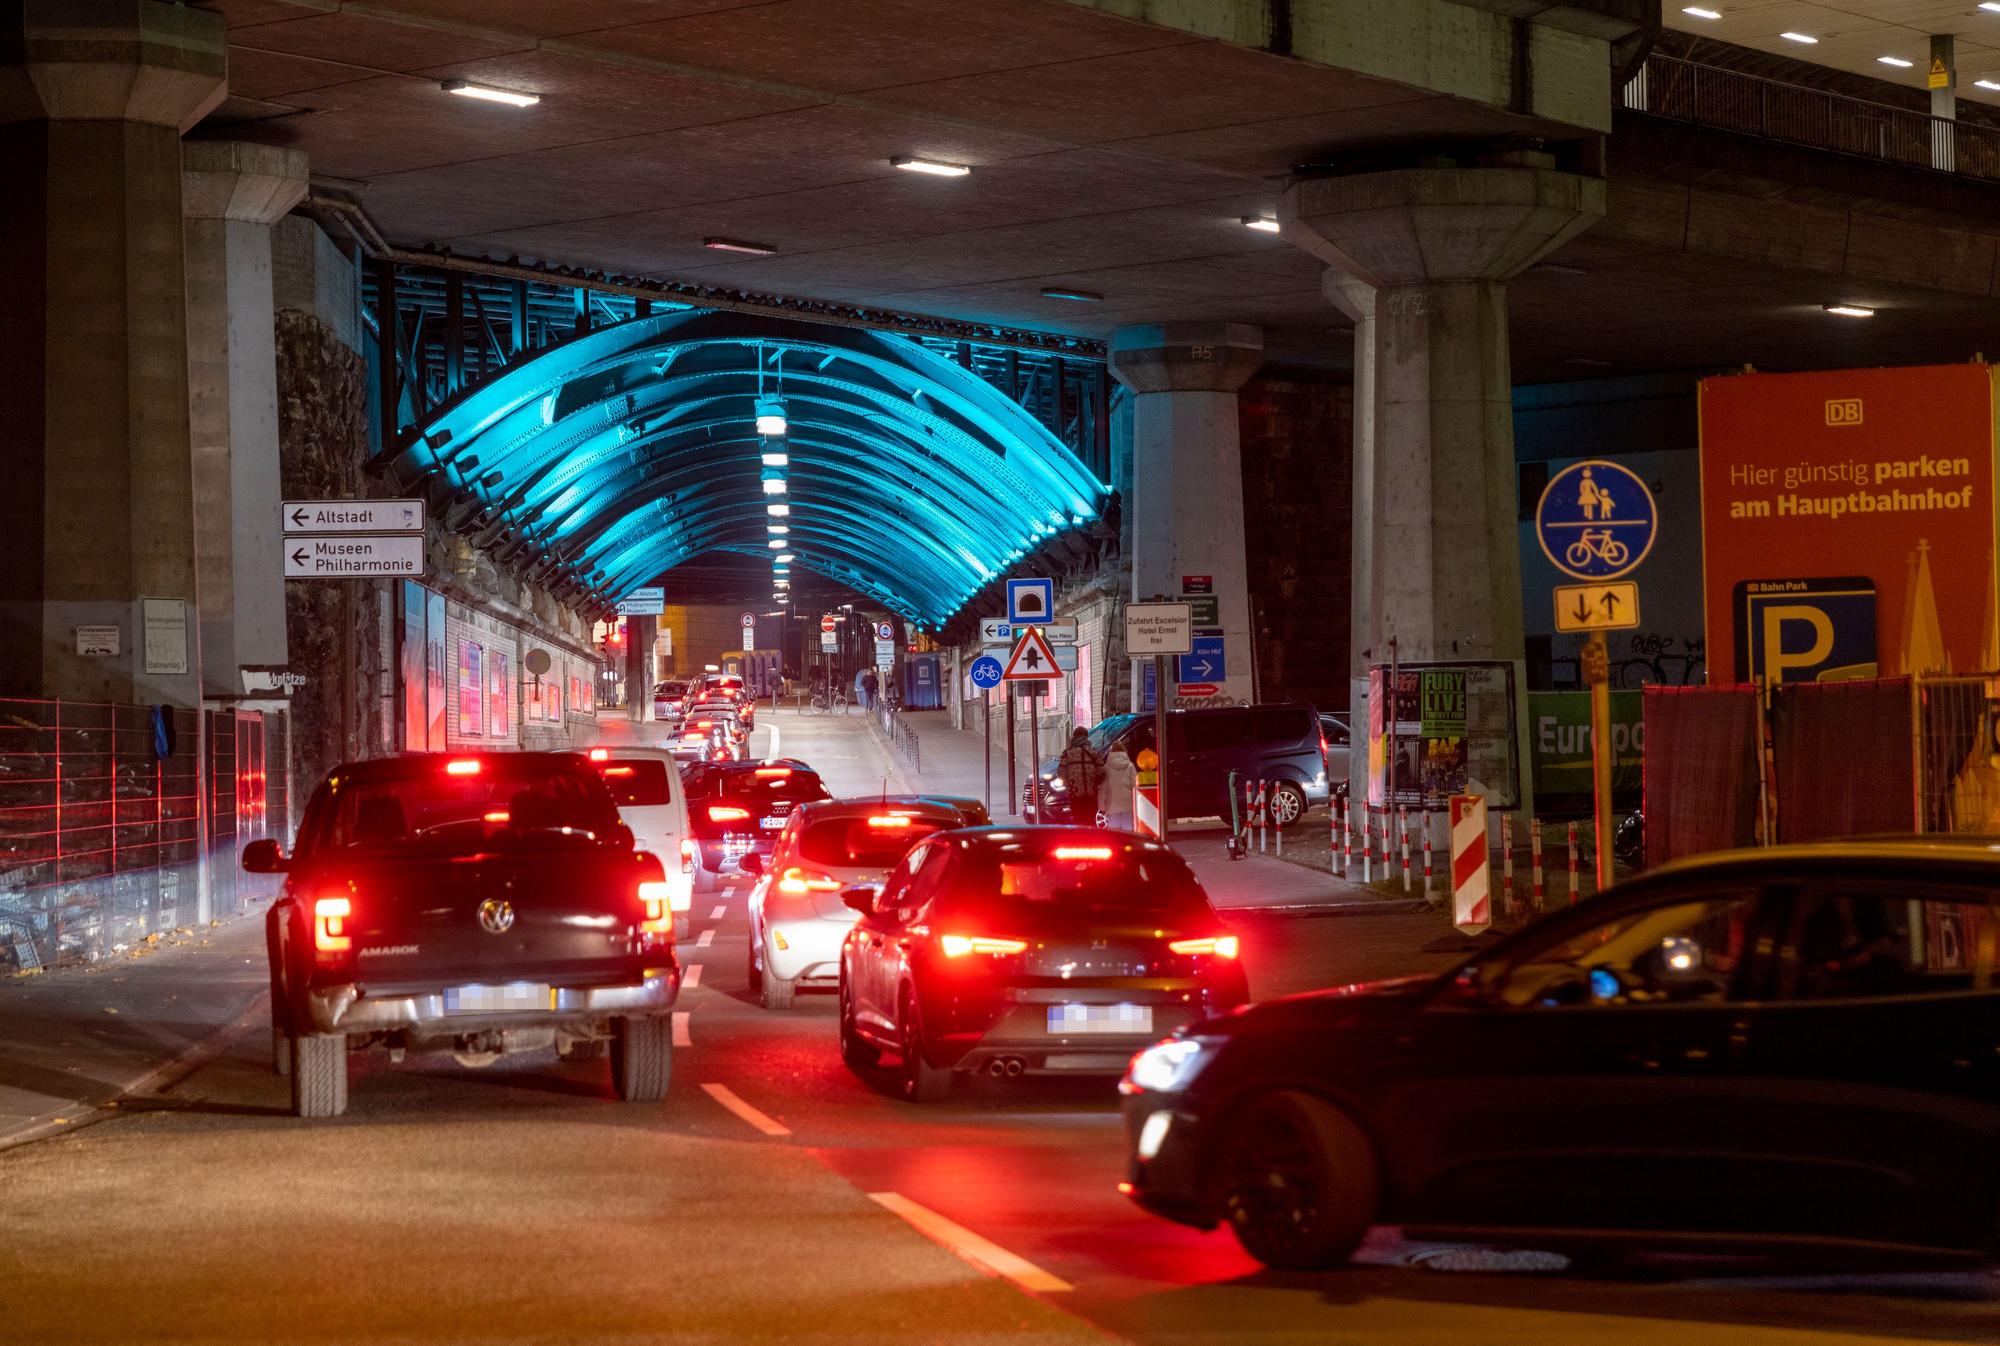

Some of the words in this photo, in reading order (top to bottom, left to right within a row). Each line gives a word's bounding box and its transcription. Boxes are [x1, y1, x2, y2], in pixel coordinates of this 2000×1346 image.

[1829, 402, 1859, 422] DB
[1730, 463, 1778, 486] Hier
[1784, 459, 1868, 489] günstig
[1874, 455, 1970, 484] parken
[1730, 500, 1770, 518] am
[1777, 485, 1973, 519] Hauptbahnhof
[316, 510, 373, 523] Altstadt
[315, 543, 373, 555] Museen
[315, 558, 414, 572] Philharmonie
[1760, 582, 1785, 592] Bahn
[1785, 581, 1808, 591] Park
[1128, 617, 1153, 625] Zufahrt
[1154, 616, 1187, 624] Excelsior
[1763, 605, 1835, 702] P
[1424, 672, 1464, 691] FURY
[1424, 692, 1465, 712] LIVE
[1538, 715, 1645, 767] Eurpc
[358, 944, 420, 957] AMAROK
